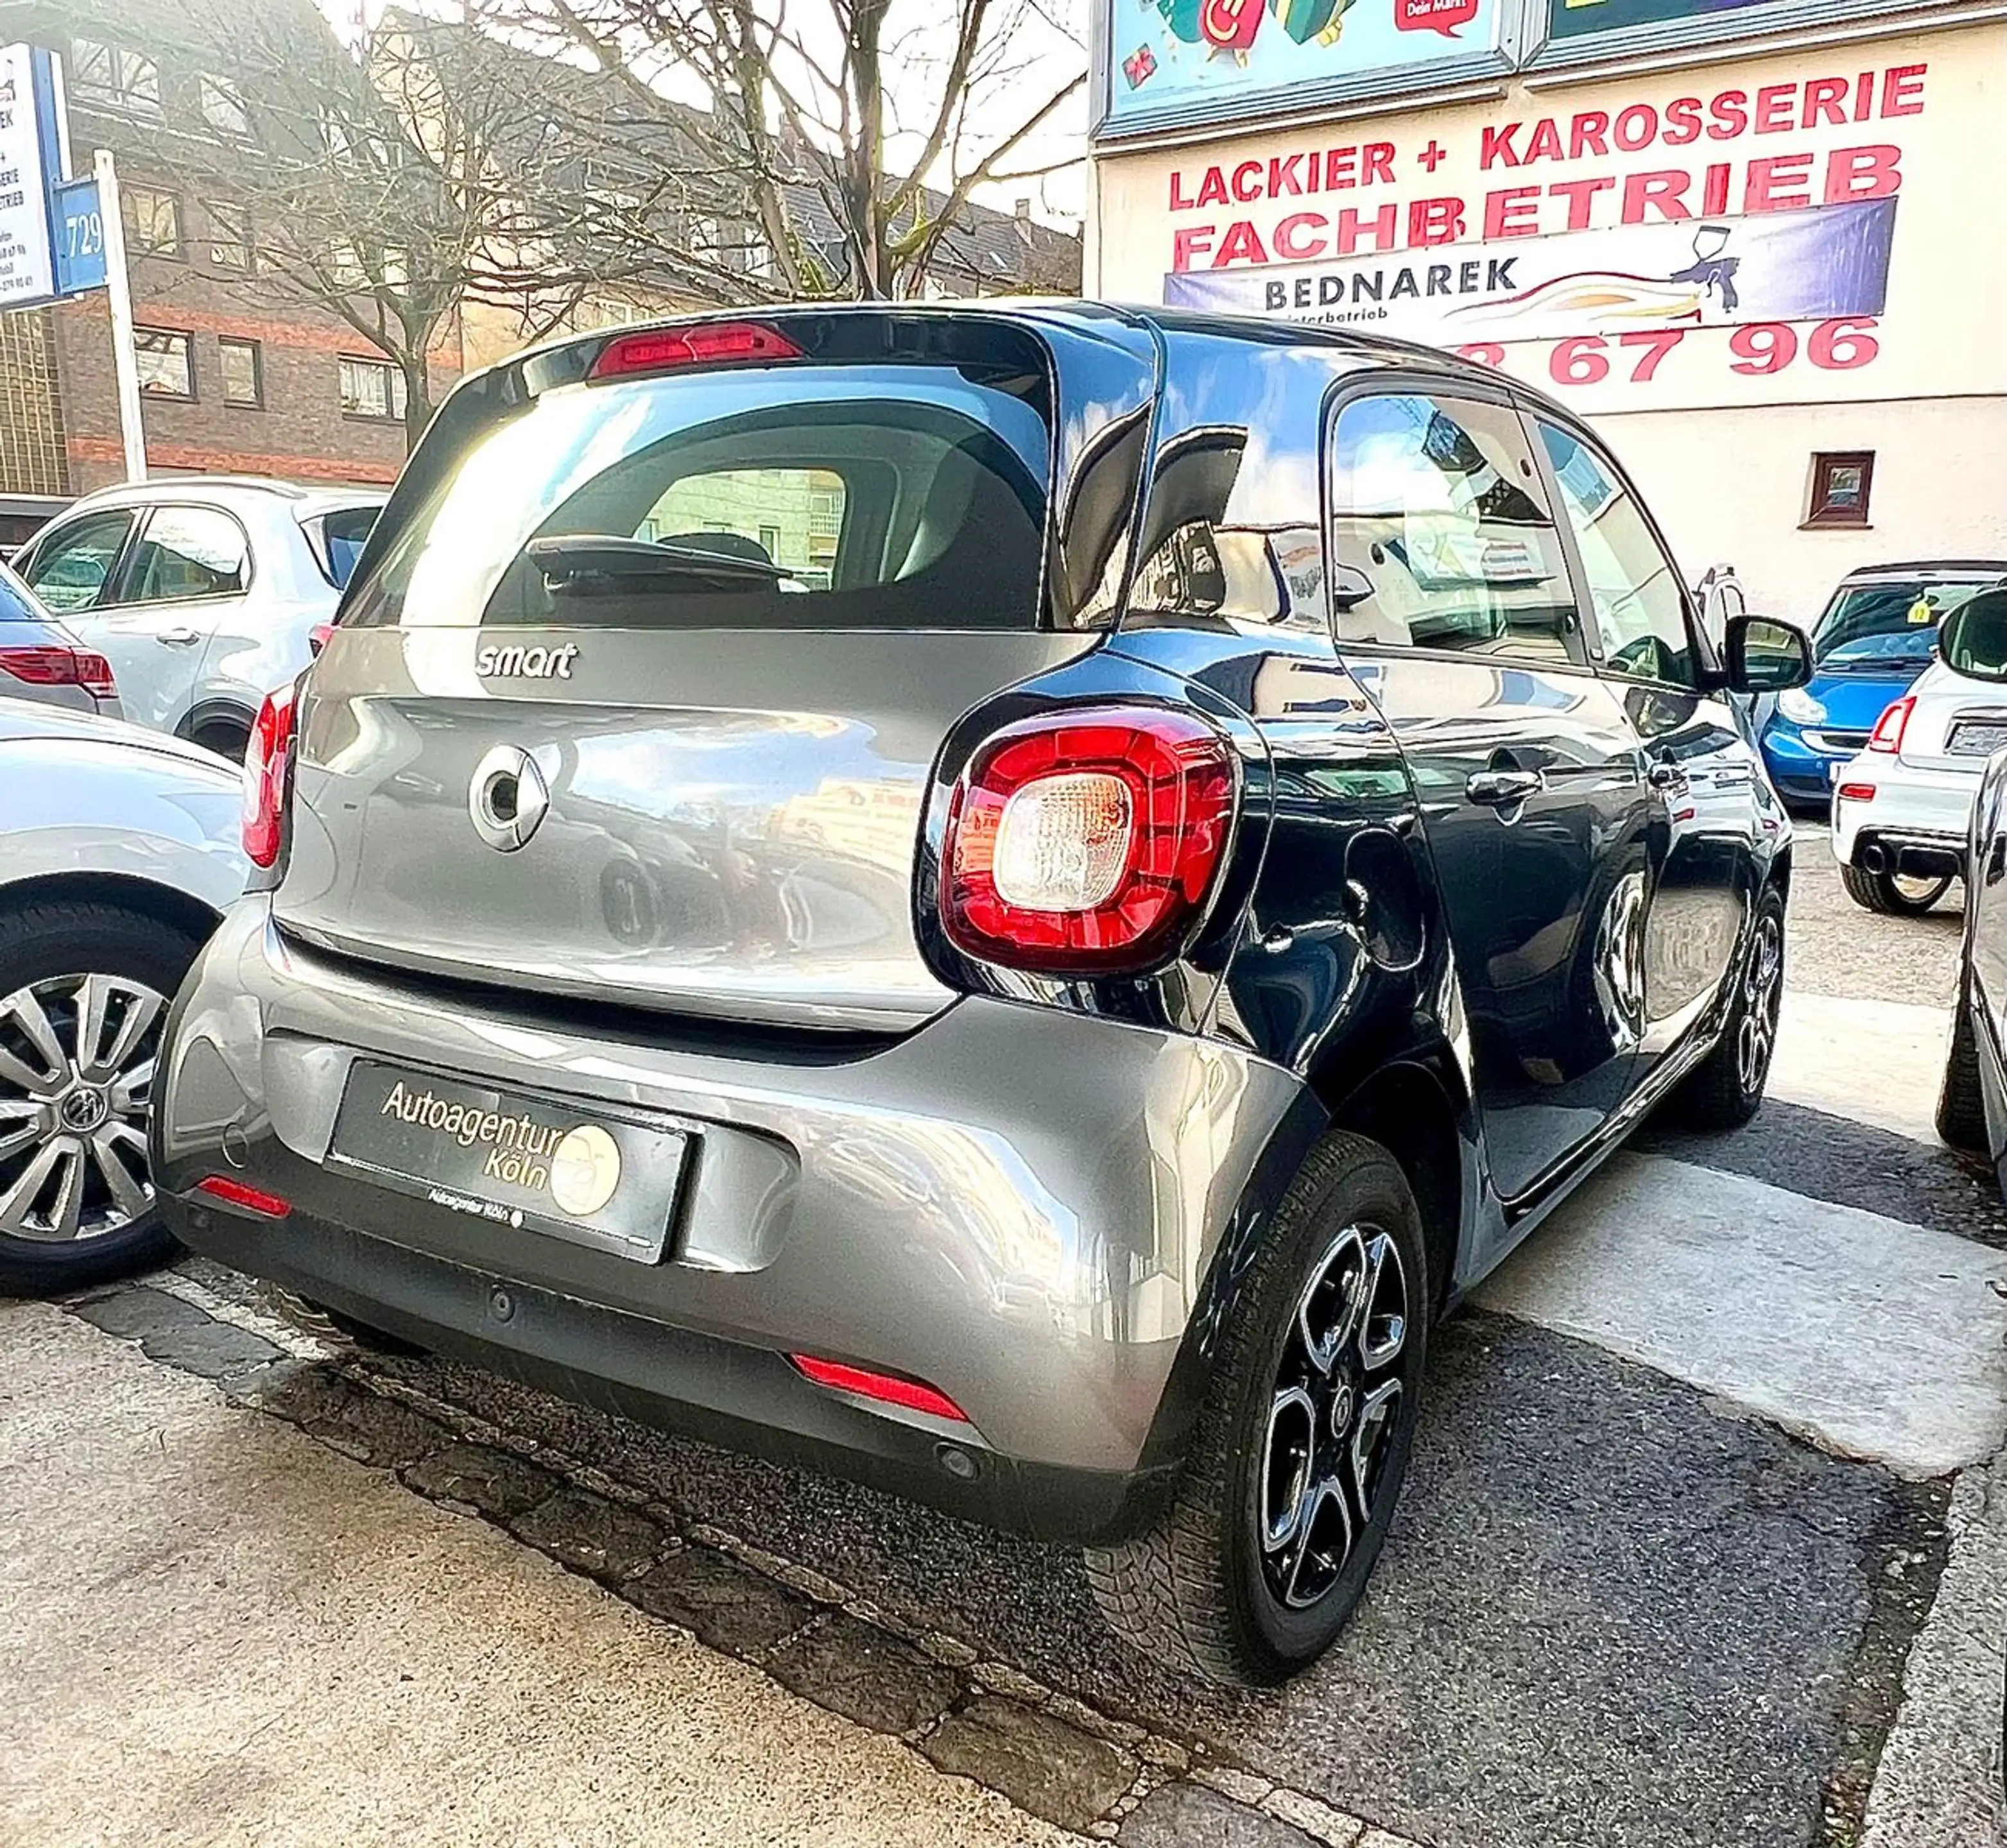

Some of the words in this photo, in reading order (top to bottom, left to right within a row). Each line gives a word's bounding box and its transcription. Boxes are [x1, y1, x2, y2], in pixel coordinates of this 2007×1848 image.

[1408, 2, 1431, 17] Dein
[1169, 141, 1396, 212] LACKIER
[1417, 140, 1446, 173] +
[1479, 64, 1928, 171] KAROSSERIE
[66, 212, 103, 259] 729
[1172, 144, 1902, 275] FACHBETRIEB
[1265, 256, 1520, 311] BEDNAREK
[1549, 329, 1685, 385] 67
[1729, 317, 1879, 375] 96
[475, 642, 579, 680] smart
[381, 1080, 564, 1158] Autoagentur
[483, 1148, 549, 1192] Köln
